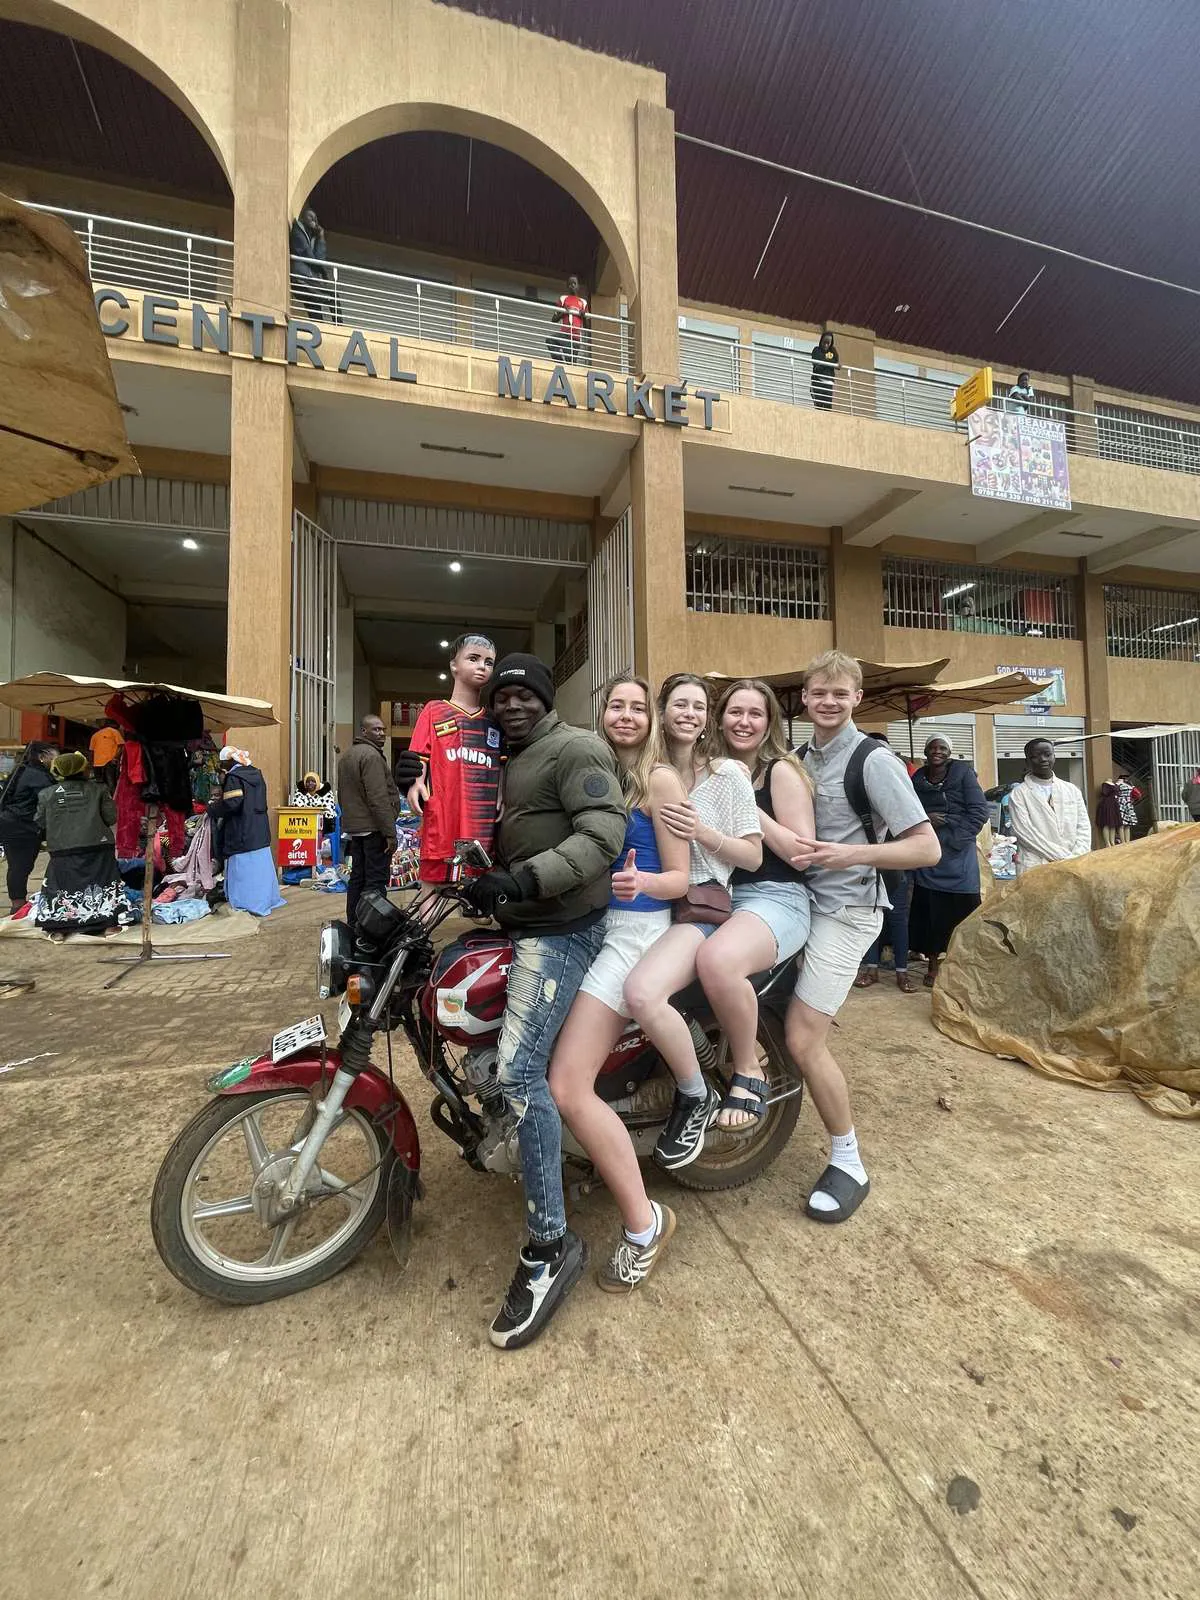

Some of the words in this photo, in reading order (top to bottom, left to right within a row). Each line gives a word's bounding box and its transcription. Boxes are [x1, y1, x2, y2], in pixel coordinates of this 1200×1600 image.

[96, 289, 417, 384] CENTRAL
[498, 355, 720, 430] MARKET
[997, 666, 1011, 674] GOD
[1038, 668, 1046, 676] US
[288, 818, 308, 826] MTN
[288, 850, 307, 859] airtel
